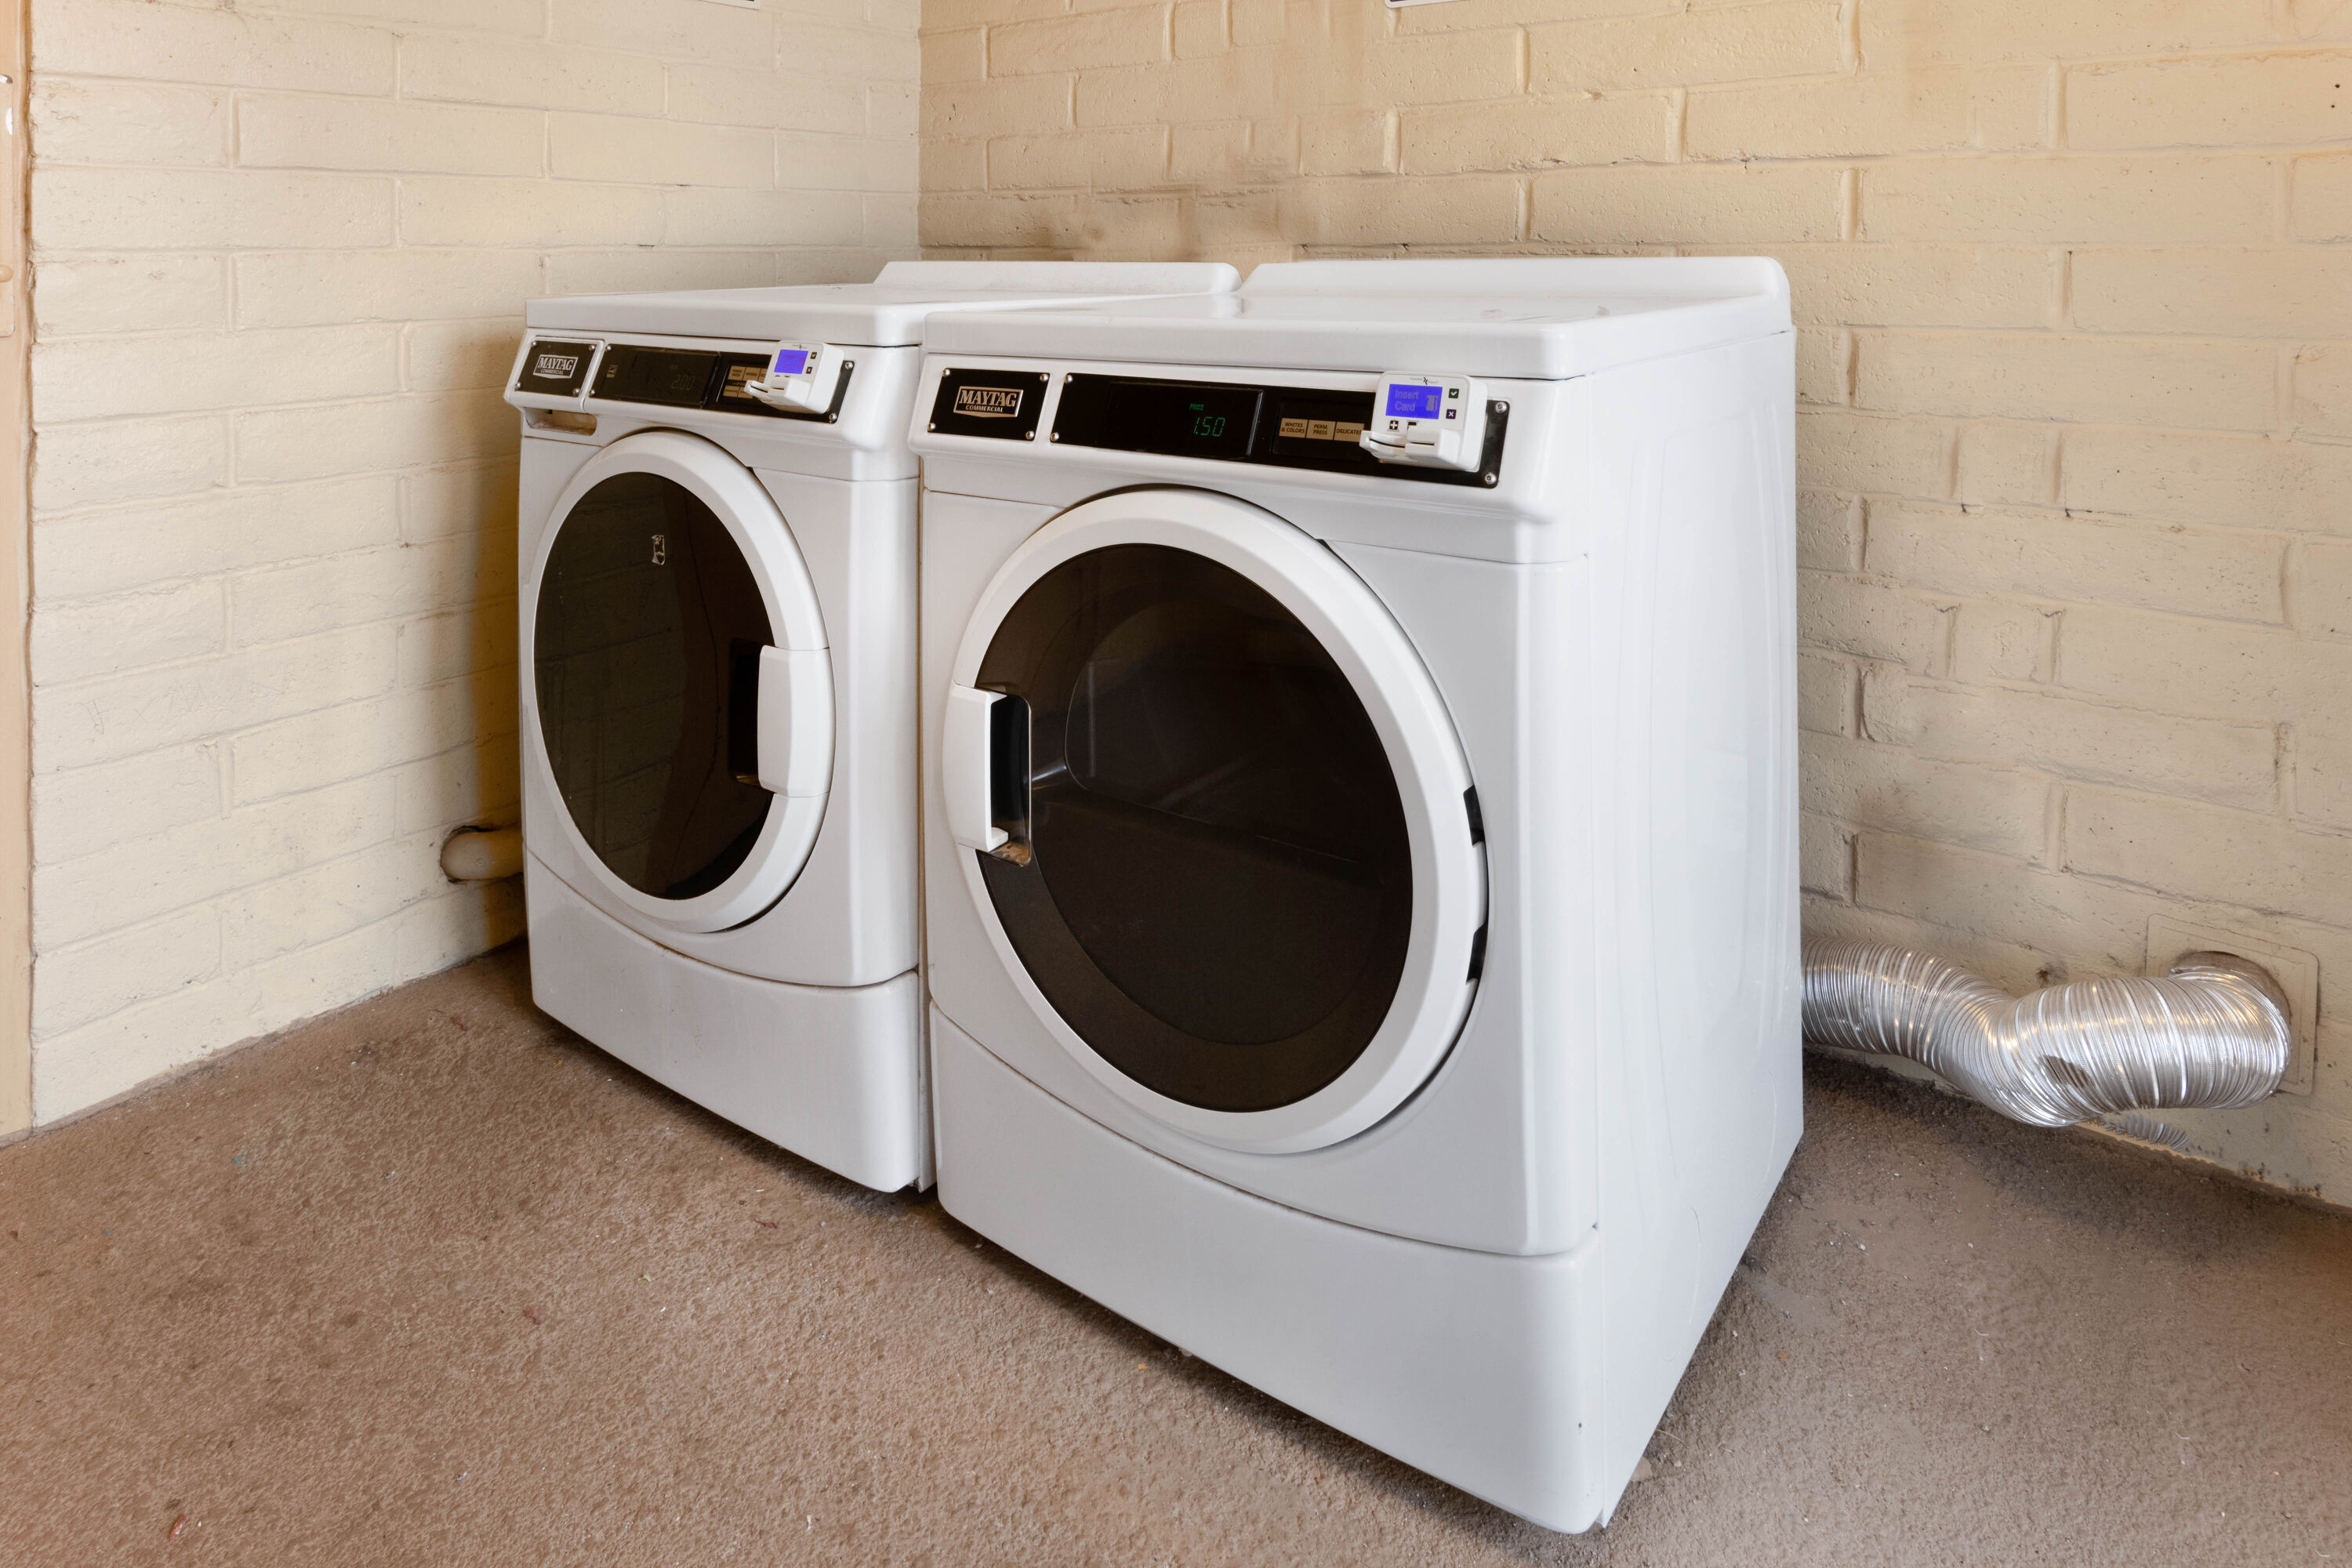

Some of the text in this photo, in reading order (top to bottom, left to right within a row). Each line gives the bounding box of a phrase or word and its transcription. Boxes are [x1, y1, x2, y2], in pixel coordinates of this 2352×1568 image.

[538, 357, 573, 370] MAYTAG
[959, 390, 1017, 407] MAYTAG
[1396, 390, 1419, 399] Insert
[1396, 401, 1416, 412] Card
[1193, 416, 1226, 437] 1.50
